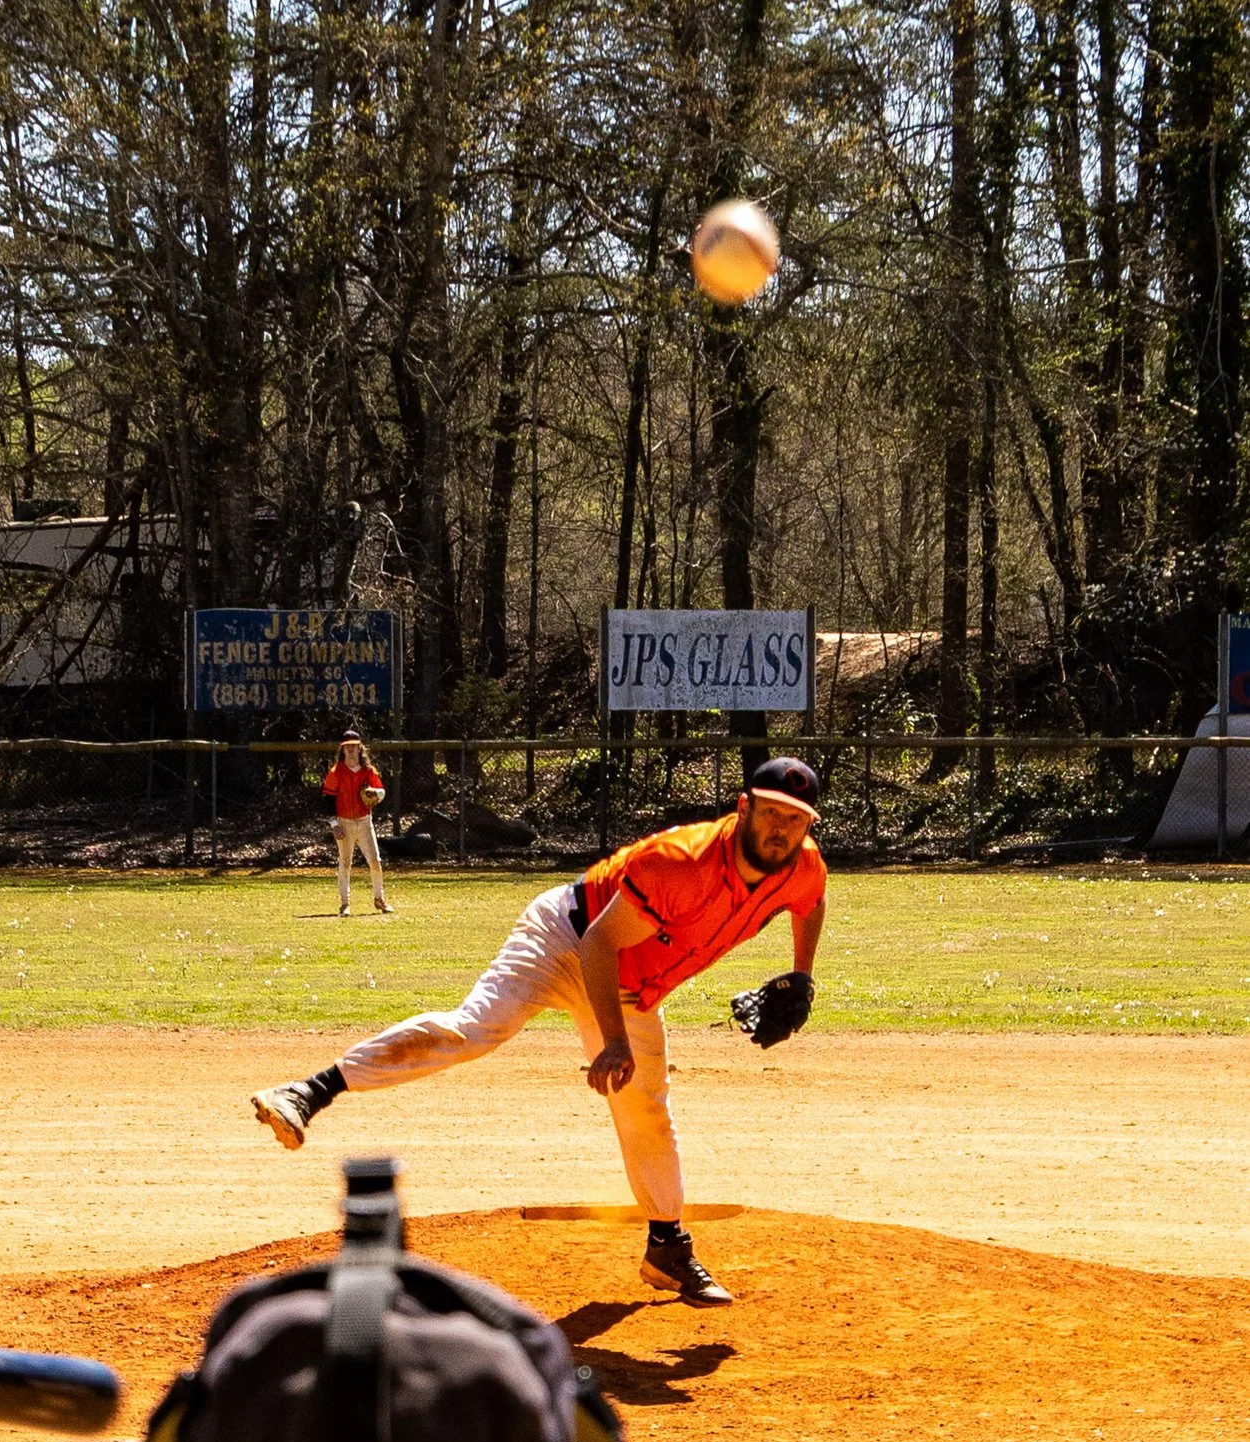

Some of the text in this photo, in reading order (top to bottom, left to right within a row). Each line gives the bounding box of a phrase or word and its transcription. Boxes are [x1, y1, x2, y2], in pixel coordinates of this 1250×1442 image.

[264, 613, 280, 640] J
[285, 613, 301, 640] &
[198, 641, 389, 665] FENCE COMPANY
[611, 632, 805, 688] JPS GLASS
[324, 666, 343, 681] SC
[212, 683, 379, 709] (864) 836-8181
